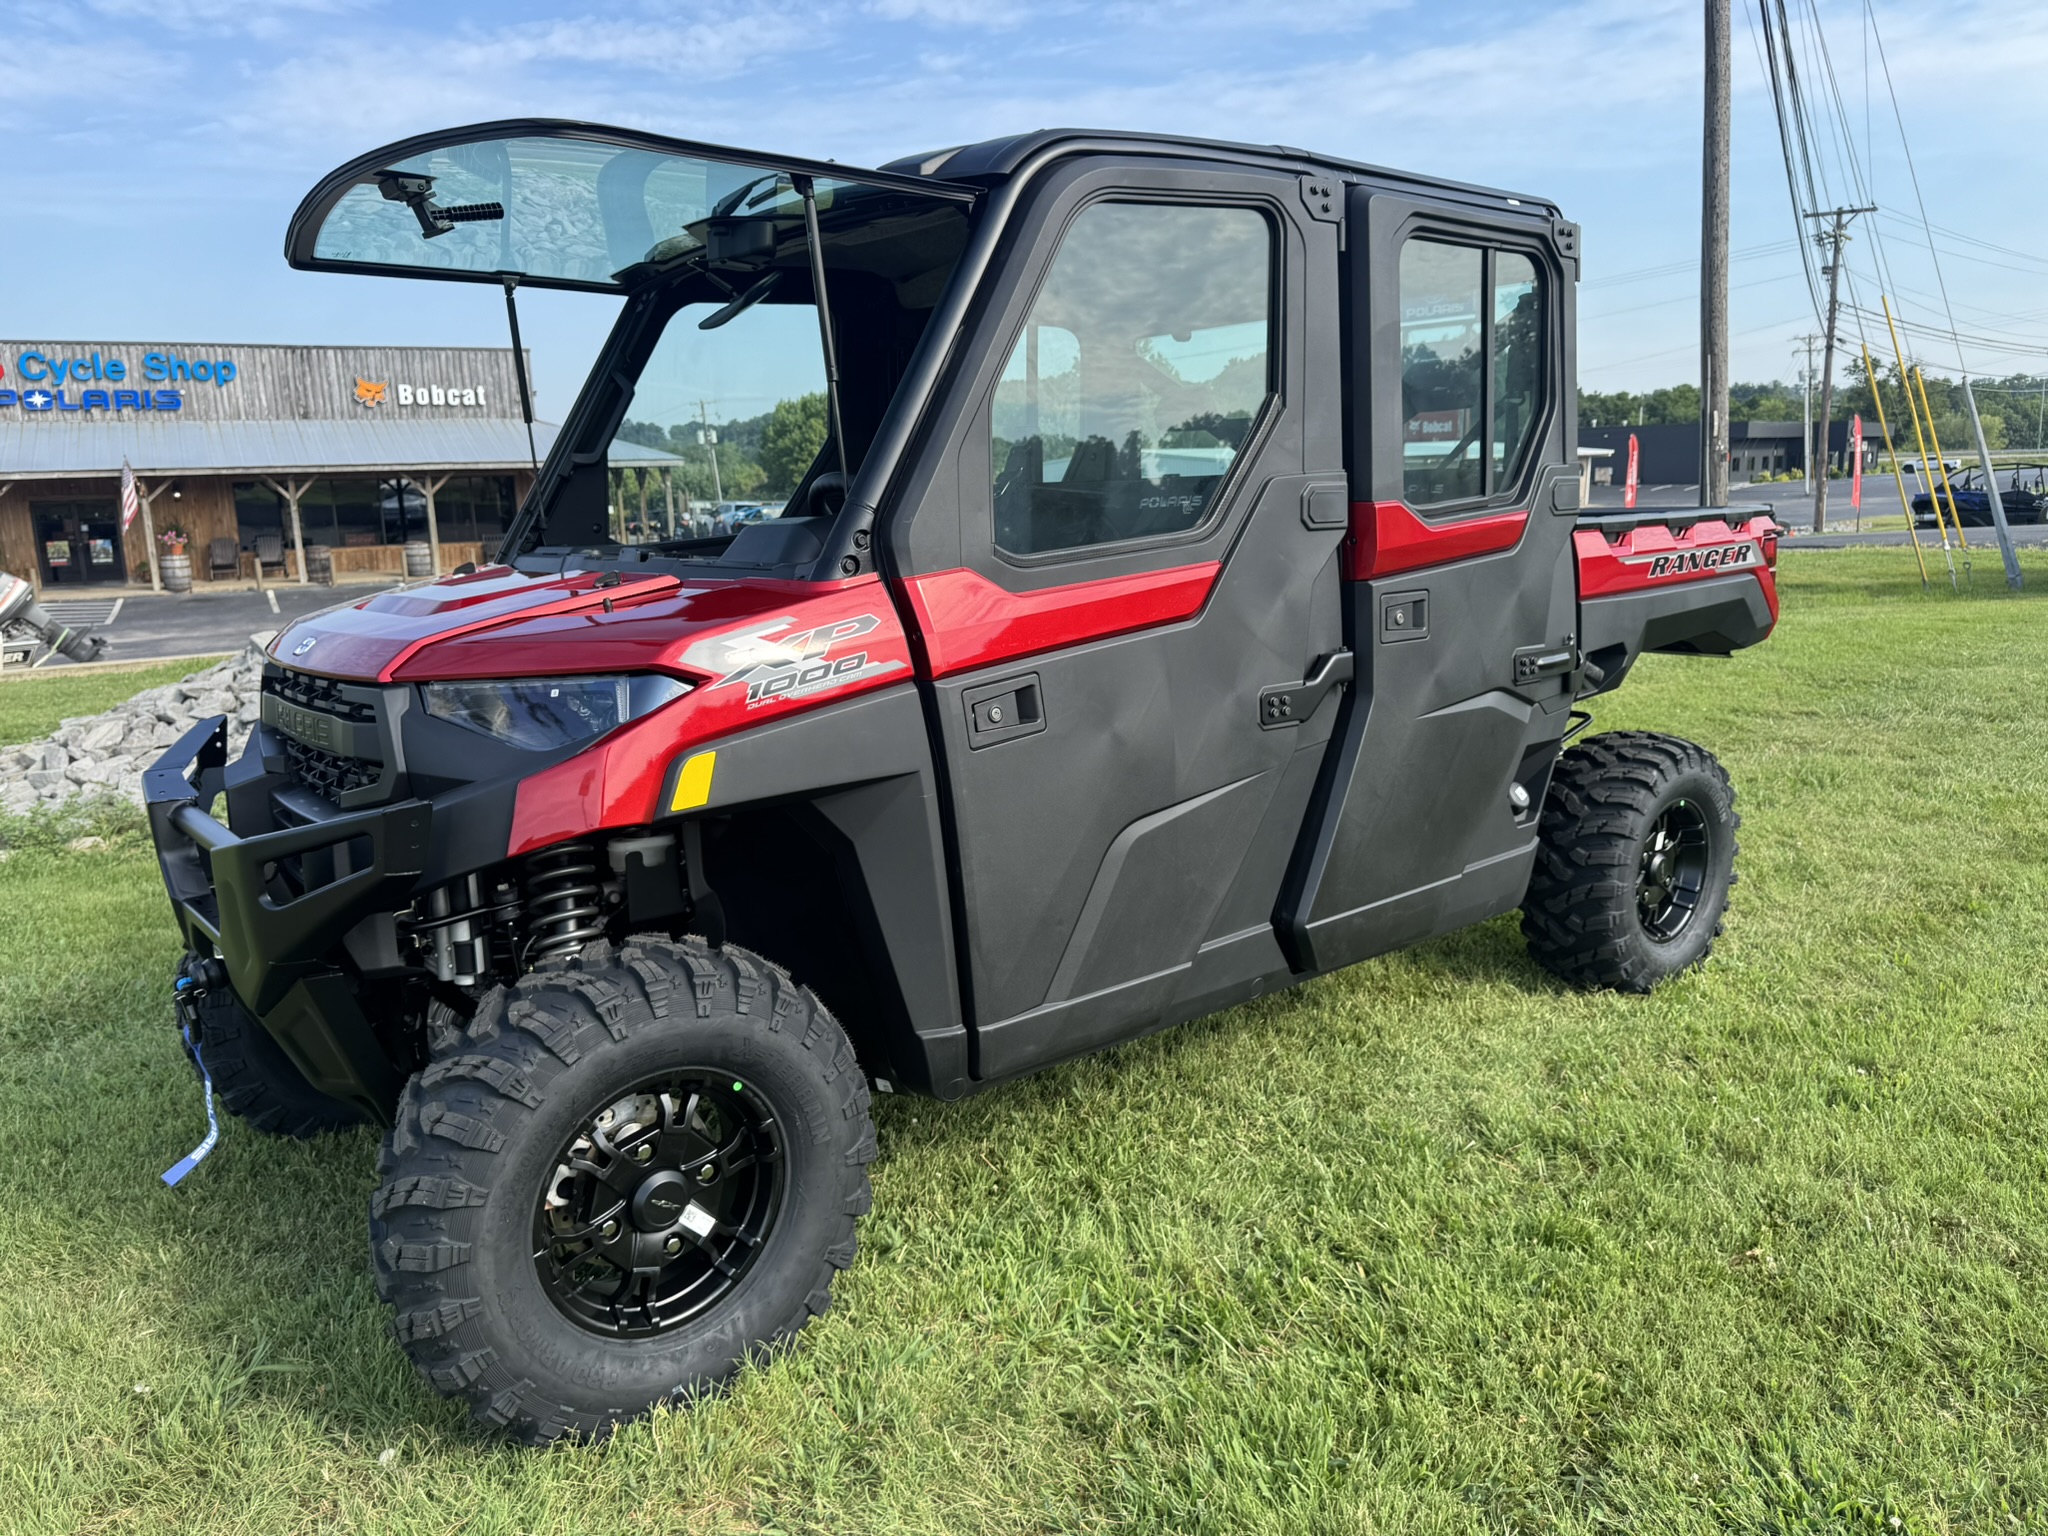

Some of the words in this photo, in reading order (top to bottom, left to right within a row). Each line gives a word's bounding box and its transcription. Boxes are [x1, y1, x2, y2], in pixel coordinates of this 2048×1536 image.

[17, 351, 127, 386] Cycle
[143, 352, 237, 387] Shop
[397, 384, 486, 406] Bobcat
[1139, 495, 1202, 509] POLARIS
[1647, 543, 1751, 578] RANGER
[703, 613, 882, 692] XP
[745, 651, 868, 704] 1000
[747, 698, 777, 710] DUAL
[778, 678, 837, 700] OVERHEAD
[839, 671, 863, 682] CAM
